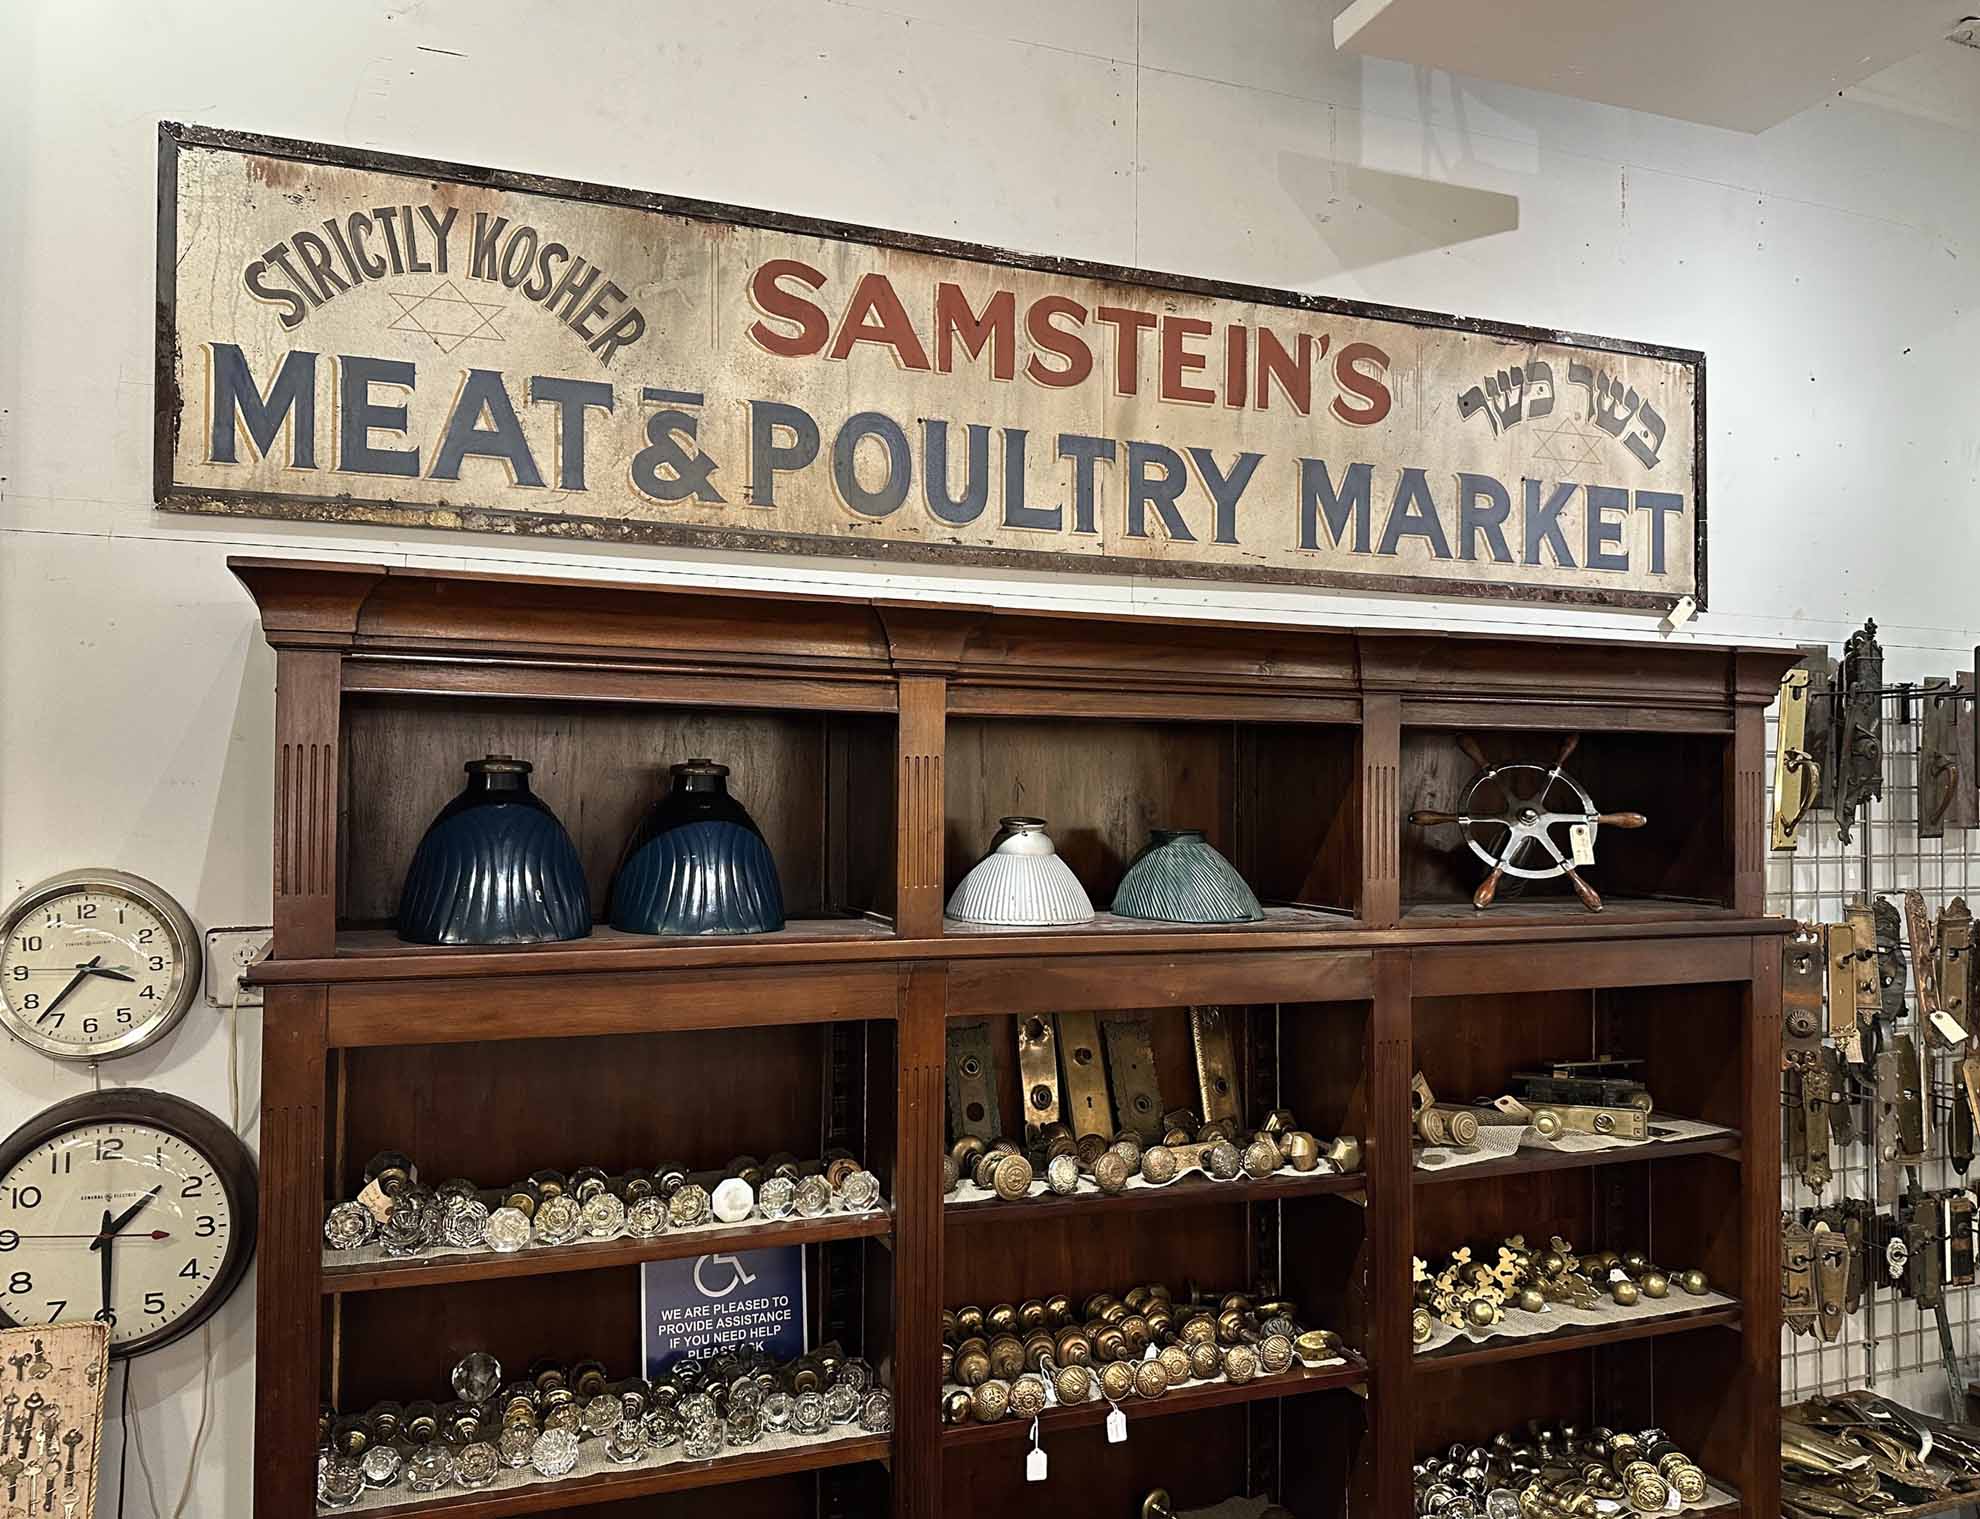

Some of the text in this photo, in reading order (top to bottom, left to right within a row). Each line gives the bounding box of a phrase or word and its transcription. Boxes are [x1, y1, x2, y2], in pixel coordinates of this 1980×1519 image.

[243, 204, 646, 368] STRICTLY KOSHER
[747, 258, 1391, 427] SAMSTEIN'S
[201, 341, 1684, 575] MEAT & POULTRY MARKET
[46, 913, 62, 928] 11
[77, 904, 97, 919] 12
[118, 909, 125, 925] 1
[22, 936, 42, 952] 10
[138, 929, 153, 944] 2
[13, 965, 29, 981] 9
[149, 956, 164, 971] 3
[24, 993, 40, 1009] 8
[139, 985, 155, 1000] 4
[50, 1013, 65, 1028] 7
[83, 1018, 98, 1033] 6
[117, 1008, 132, 1023] 5
[96, 1138, 124, 1161] 12
[155, 1146, 162, 1167] 1
[51, 1151, 71, 1174] 11
[12, 1186, 42, 1209] 10
[181, 1176, 203, 1198] 2
[195, 1215, 216, 1237] 3
[0, 1230, 20, 1251] 9
[178, 1258, 201, 1279] 4
[9, 1271, 33, 1294] 8
[46, 1301, 67, 1323] 7
[143, 1292, 166, 1314] 5
[661, 1295, 789, 1321] WE ARE PLEASED TO
[658, 1309, 792, 1336] PROVIDE ASSISTANCE
[669, 1325, 781, 1349] IF YOU NEED HELP
